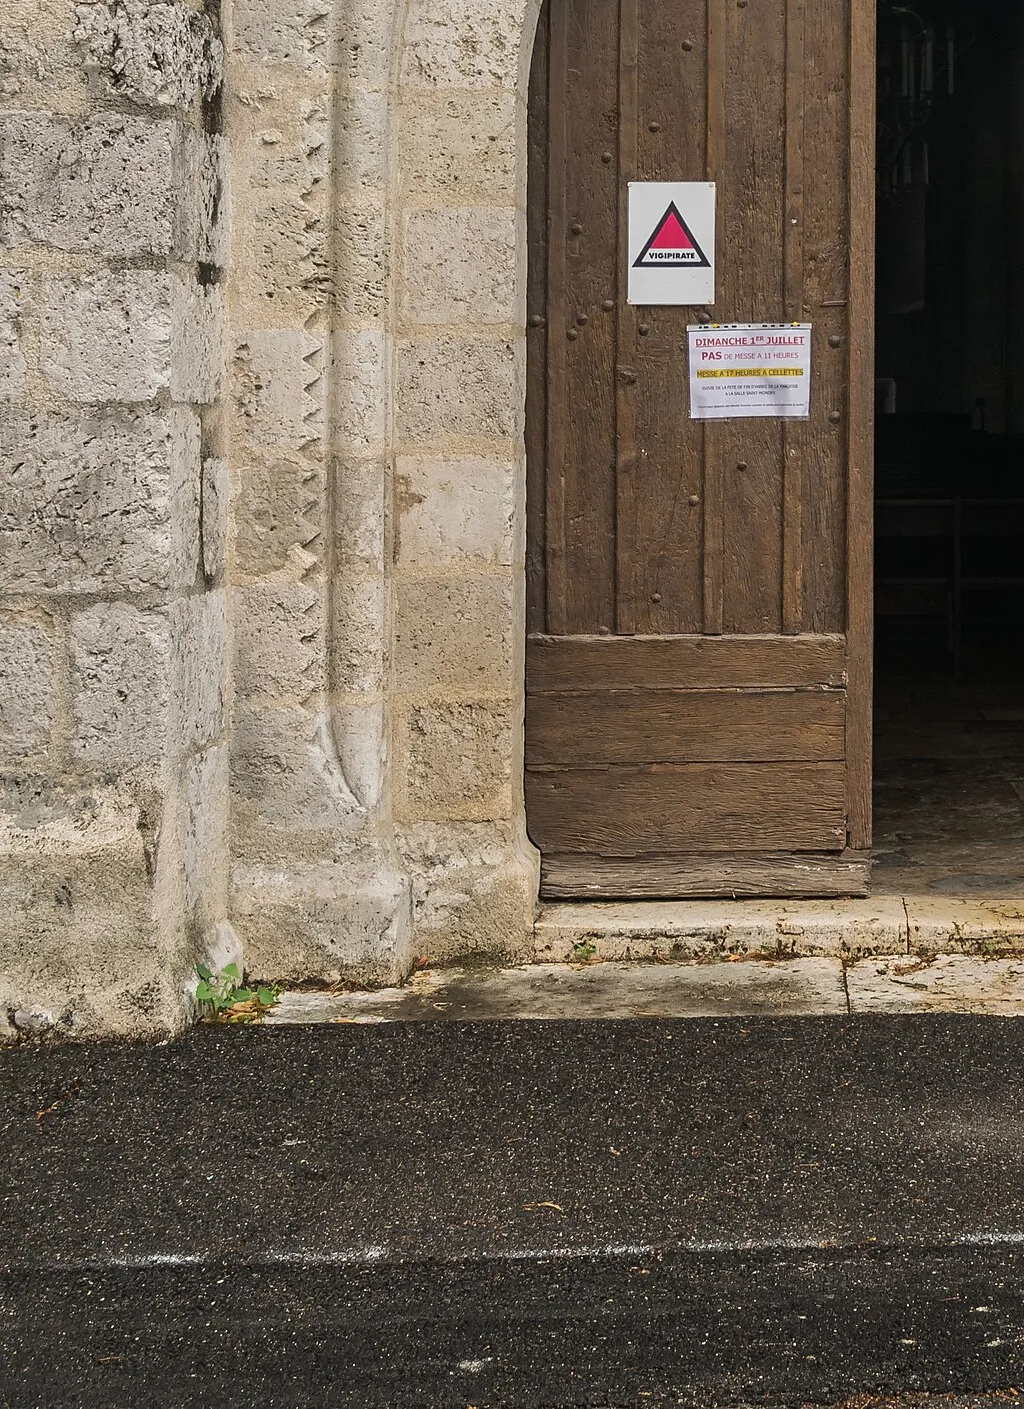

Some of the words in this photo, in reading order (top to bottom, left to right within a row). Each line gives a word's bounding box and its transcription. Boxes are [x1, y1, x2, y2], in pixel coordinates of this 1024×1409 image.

[648, 252, 696, 260] VIGIPIRATE
[695, 337, 748, 346] DIMANCHE
[750, 335, 765, 345] 1ER
[767, 336, 805, 345] JUILLET
[701, 351, 722, 361] PAS
[697, 370, 718, 378] MESSE
[735, 369, 761, 377] HEURES
[768, 368, 804, 376] CELLETTES
